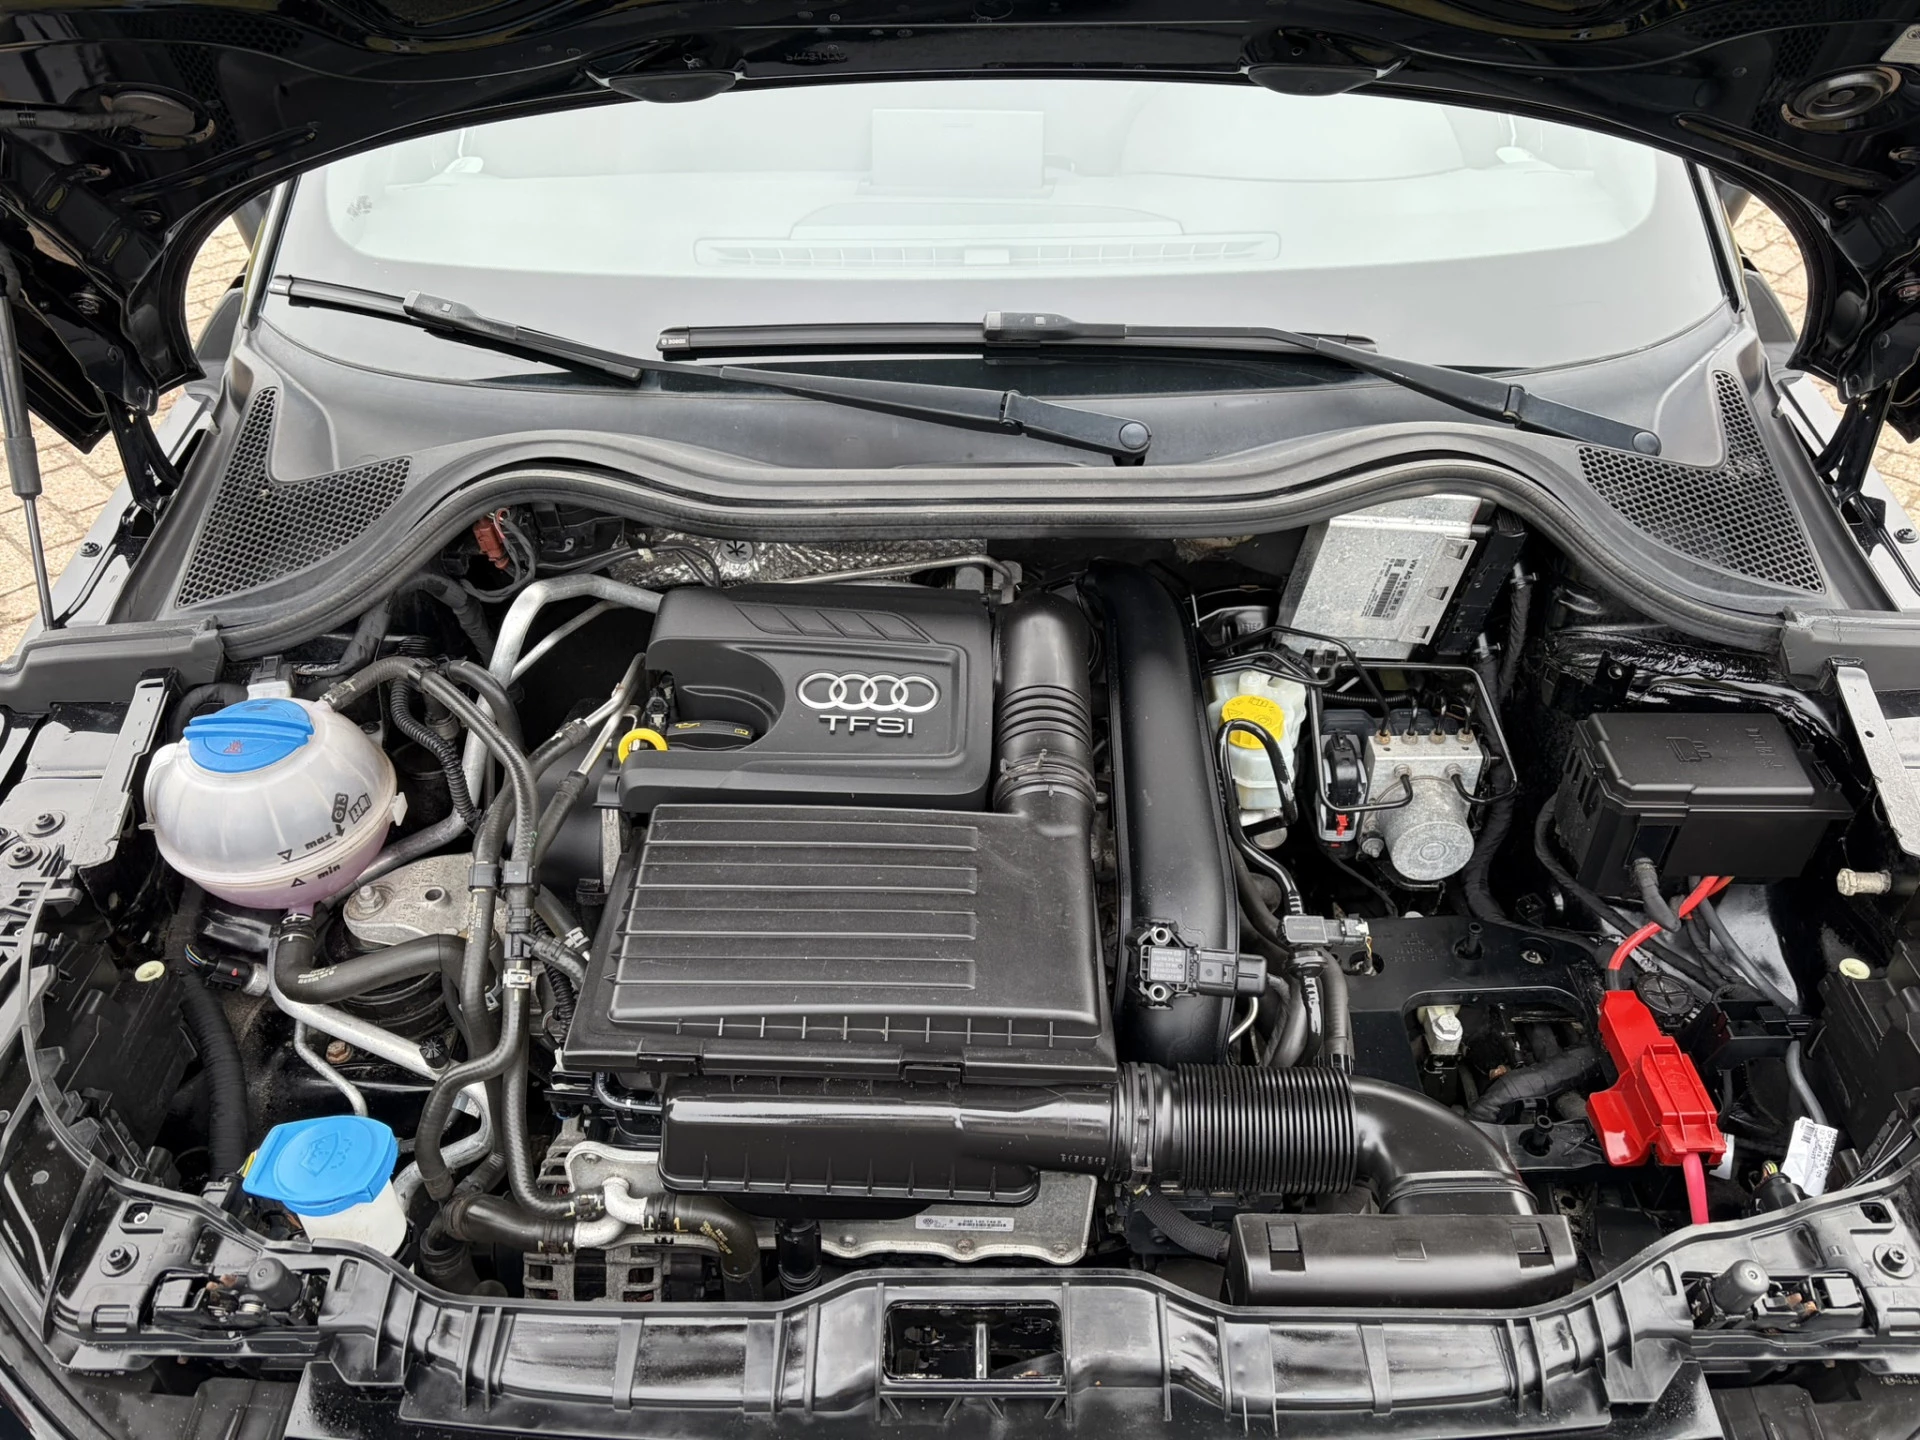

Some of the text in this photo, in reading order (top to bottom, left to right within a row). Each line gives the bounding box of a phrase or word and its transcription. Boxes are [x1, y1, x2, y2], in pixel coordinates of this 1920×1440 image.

[819, 714, 914, 736] TFSI
[334, 794, 347, 820] G13
[304, 832, 333, 850] max
[317, 864, 341, 879] min
